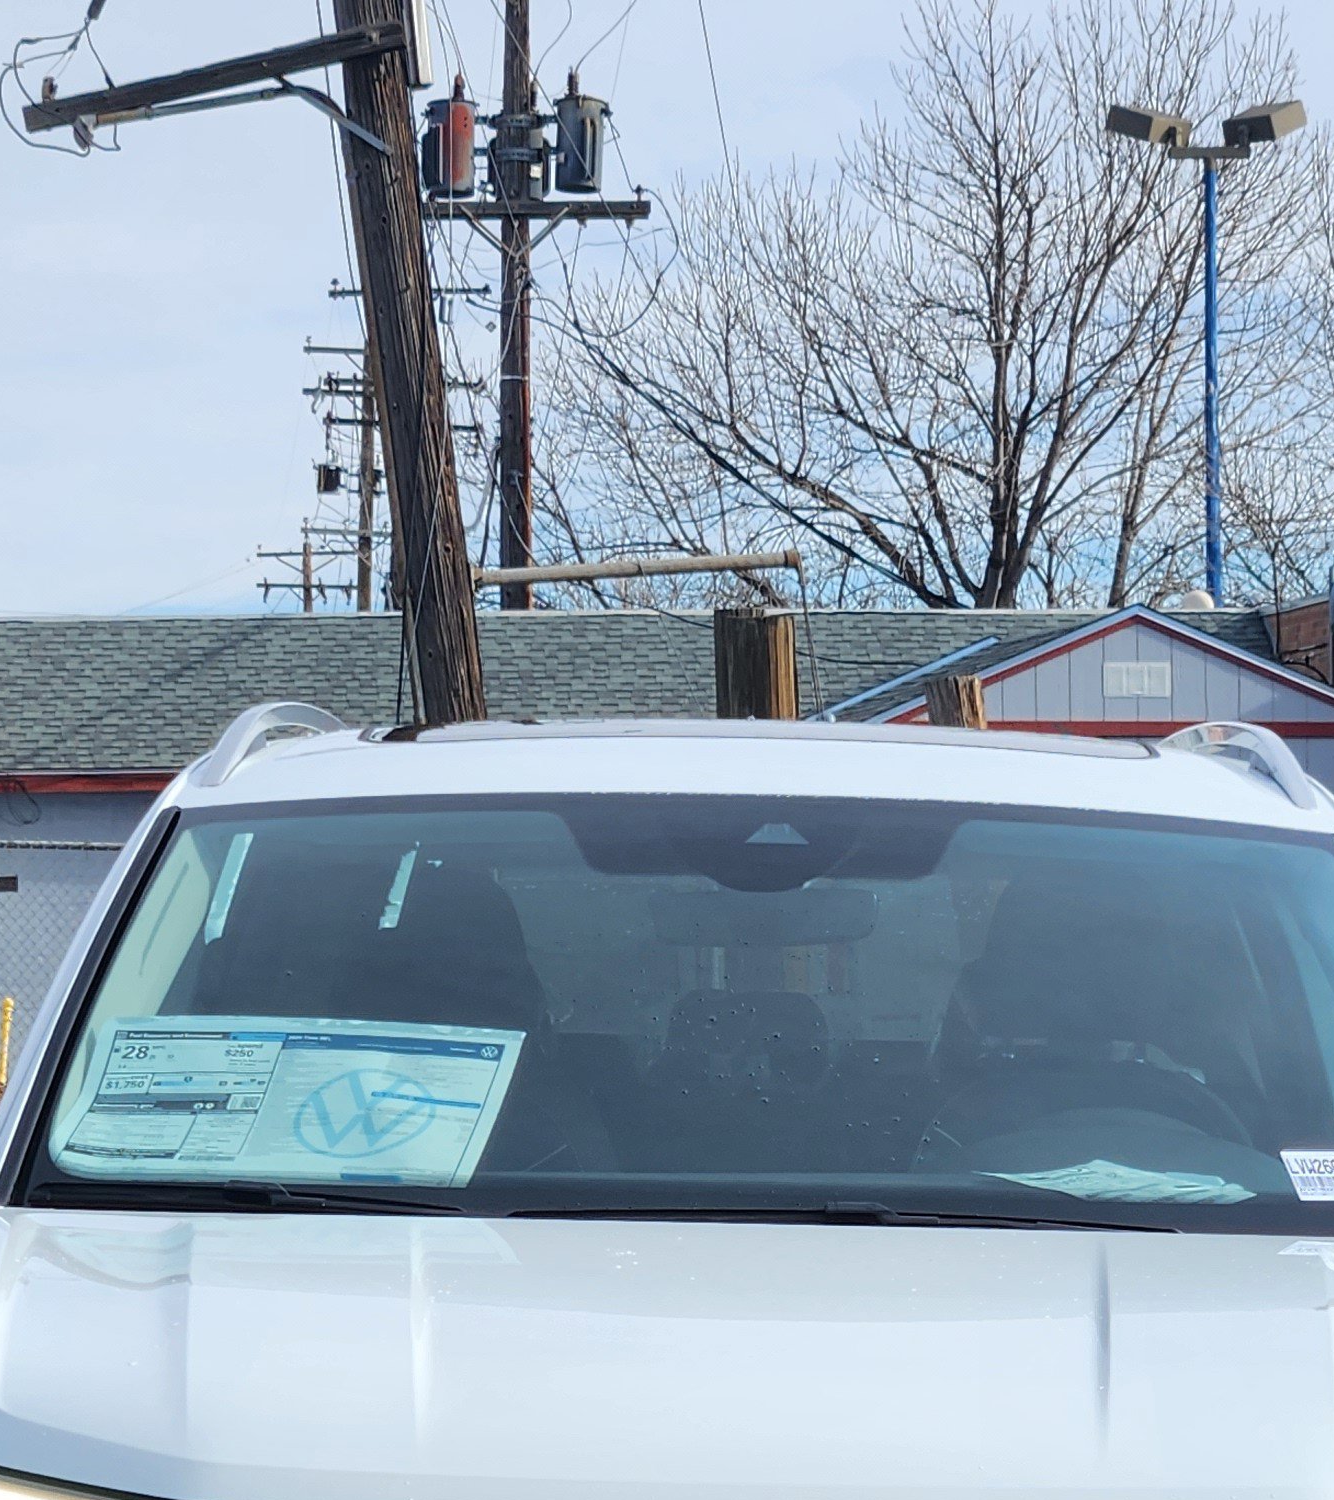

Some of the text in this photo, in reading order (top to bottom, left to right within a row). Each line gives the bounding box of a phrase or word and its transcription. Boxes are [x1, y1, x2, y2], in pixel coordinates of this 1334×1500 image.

[121, 1045, 150, 1060] 28
[224, 1049, 255, 1058] $250
[105, 1080, 145, 1090] $1,750
